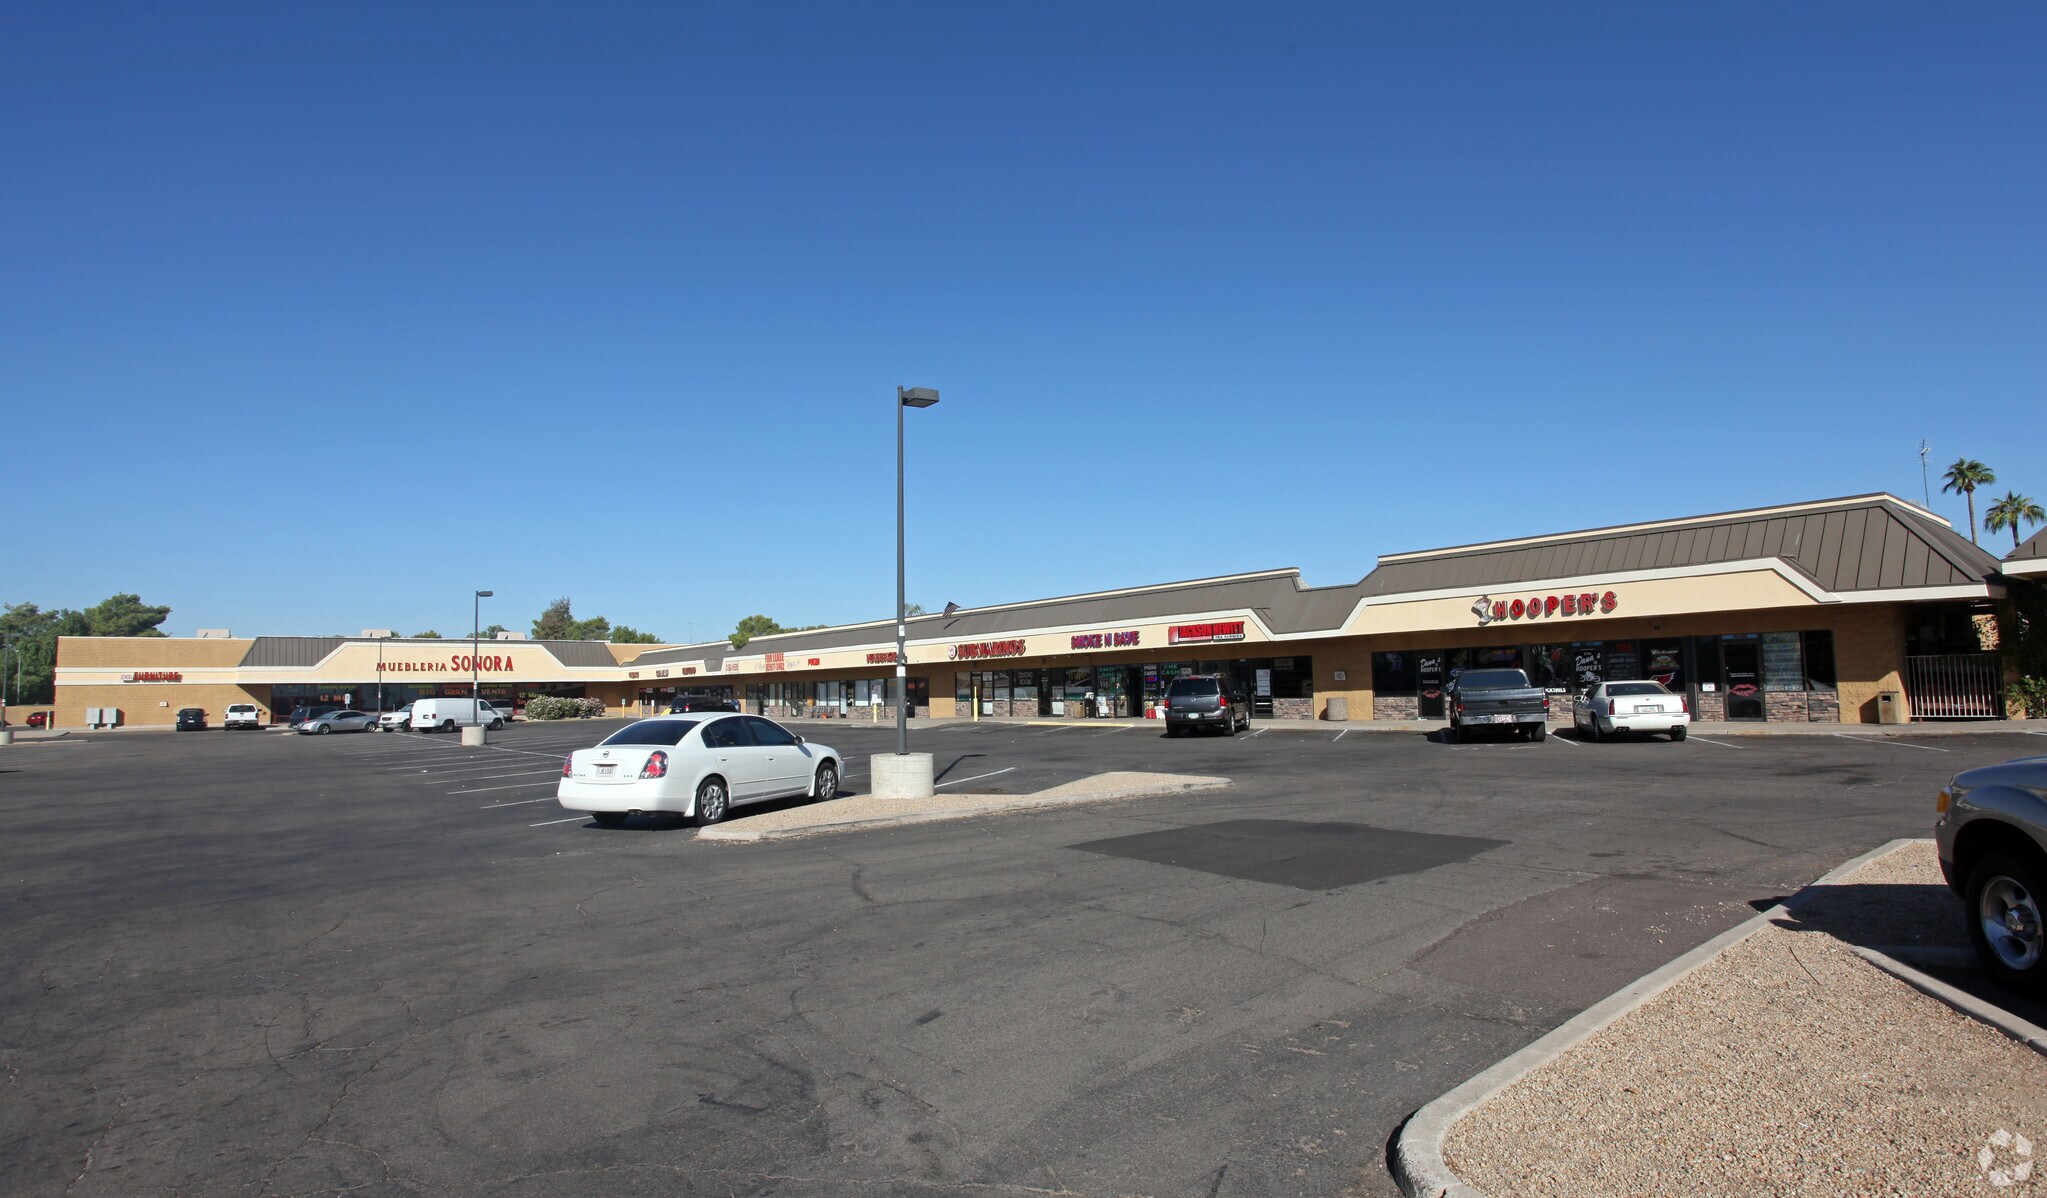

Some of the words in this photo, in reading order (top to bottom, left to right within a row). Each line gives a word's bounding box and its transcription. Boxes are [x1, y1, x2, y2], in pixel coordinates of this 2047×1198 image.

[1493, 591, 1617, 620] HOOPER'S
[1179, 624, 1212, 637] JACKSON
[1213, 621, 1244, 635] HEWITT
[1071, 634, 1103, 649] SMOKE
[1114, 631, 1140, 646] SAVE
[376, 662, 447, 672] MUEBLERIA
[451, 655, 514, 672] SONORA
[134, 672, 180, 681] FURNITURE
[444, 688, 468, 696] GRAN
